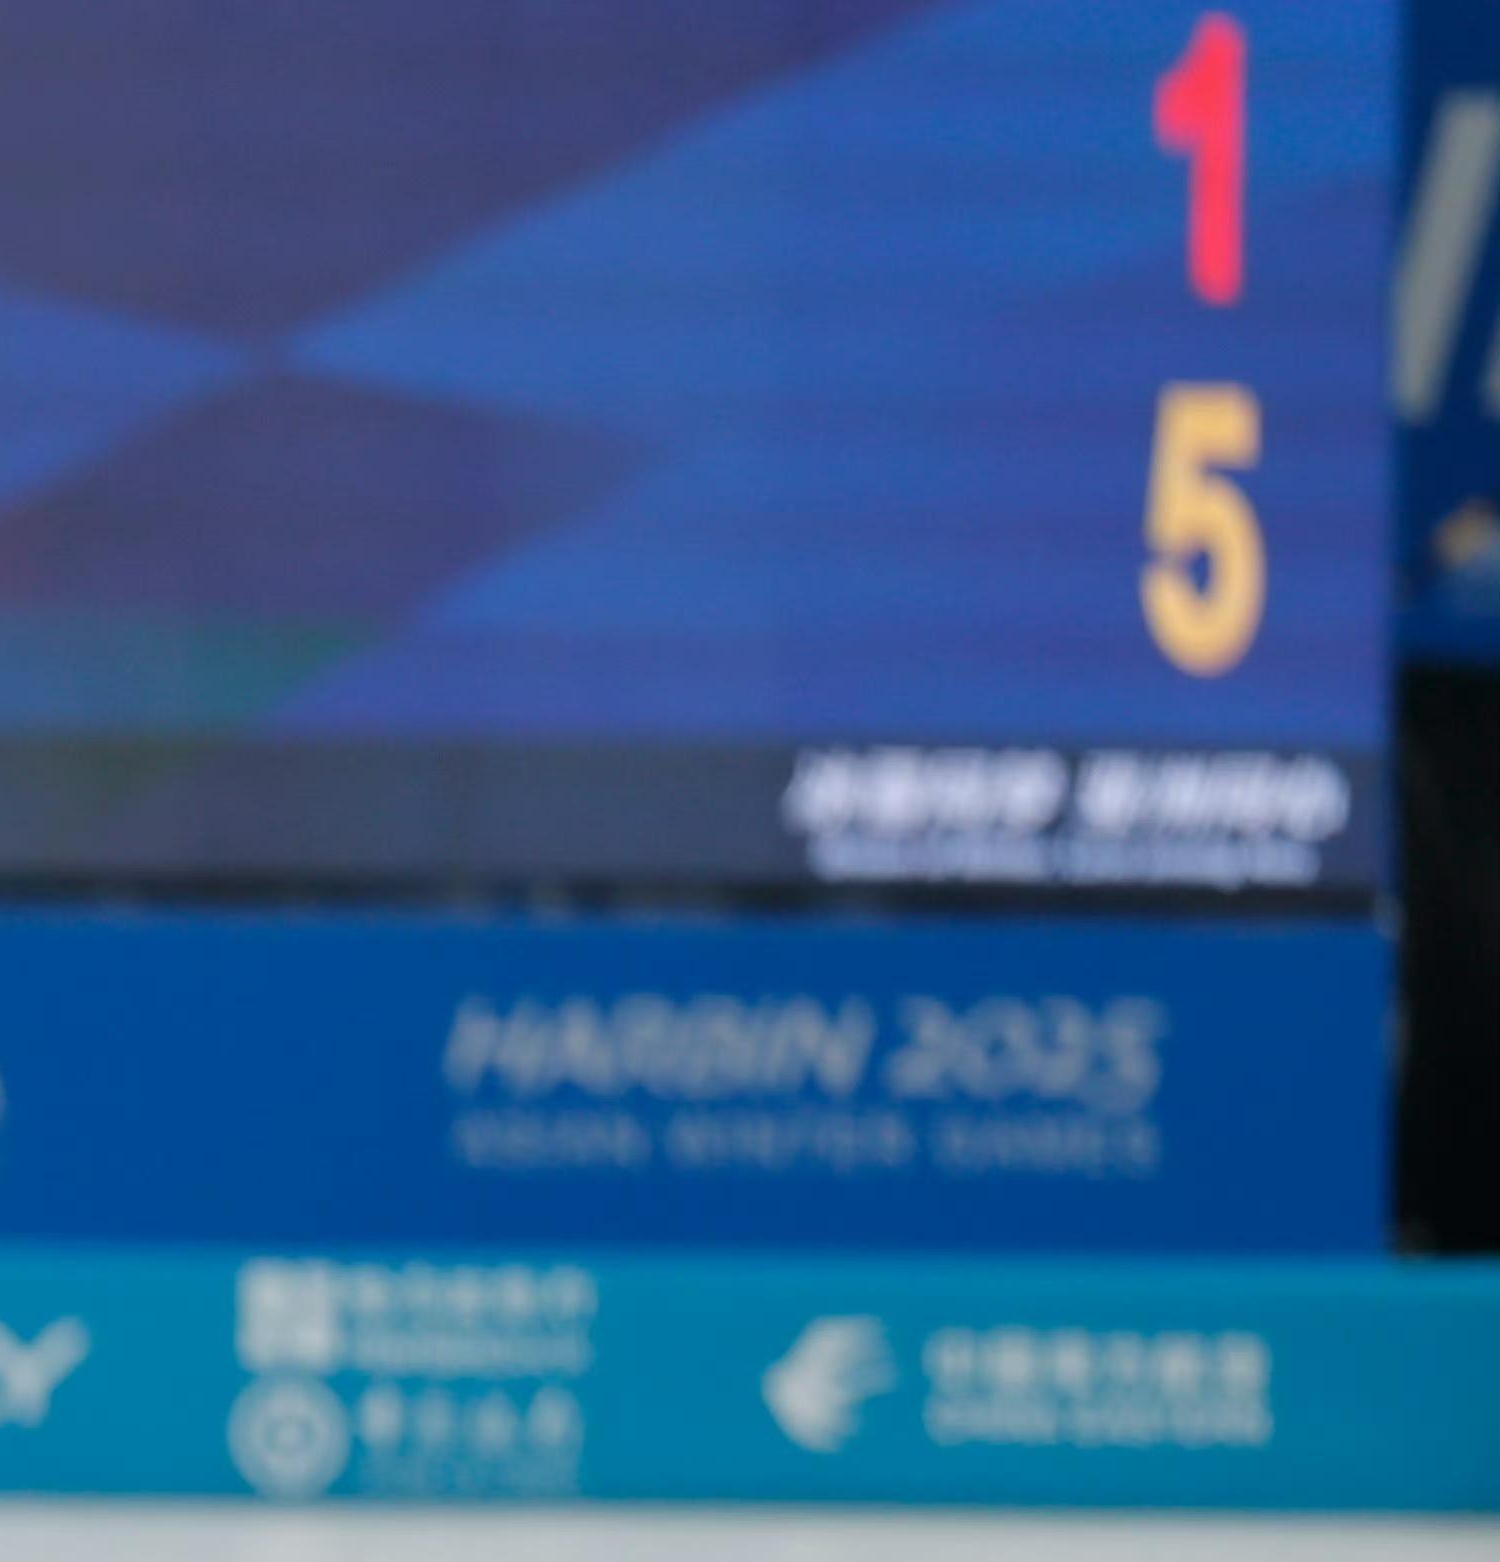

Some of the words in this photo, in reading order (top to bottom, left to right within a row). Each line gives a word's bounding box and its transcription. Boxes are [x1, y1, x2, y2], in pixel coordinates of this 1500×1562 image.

[1154, 12, 1249, 306] 1
[1140, 382, 1265, 678] 5
[886, 996, 1168, 1112] 2025
